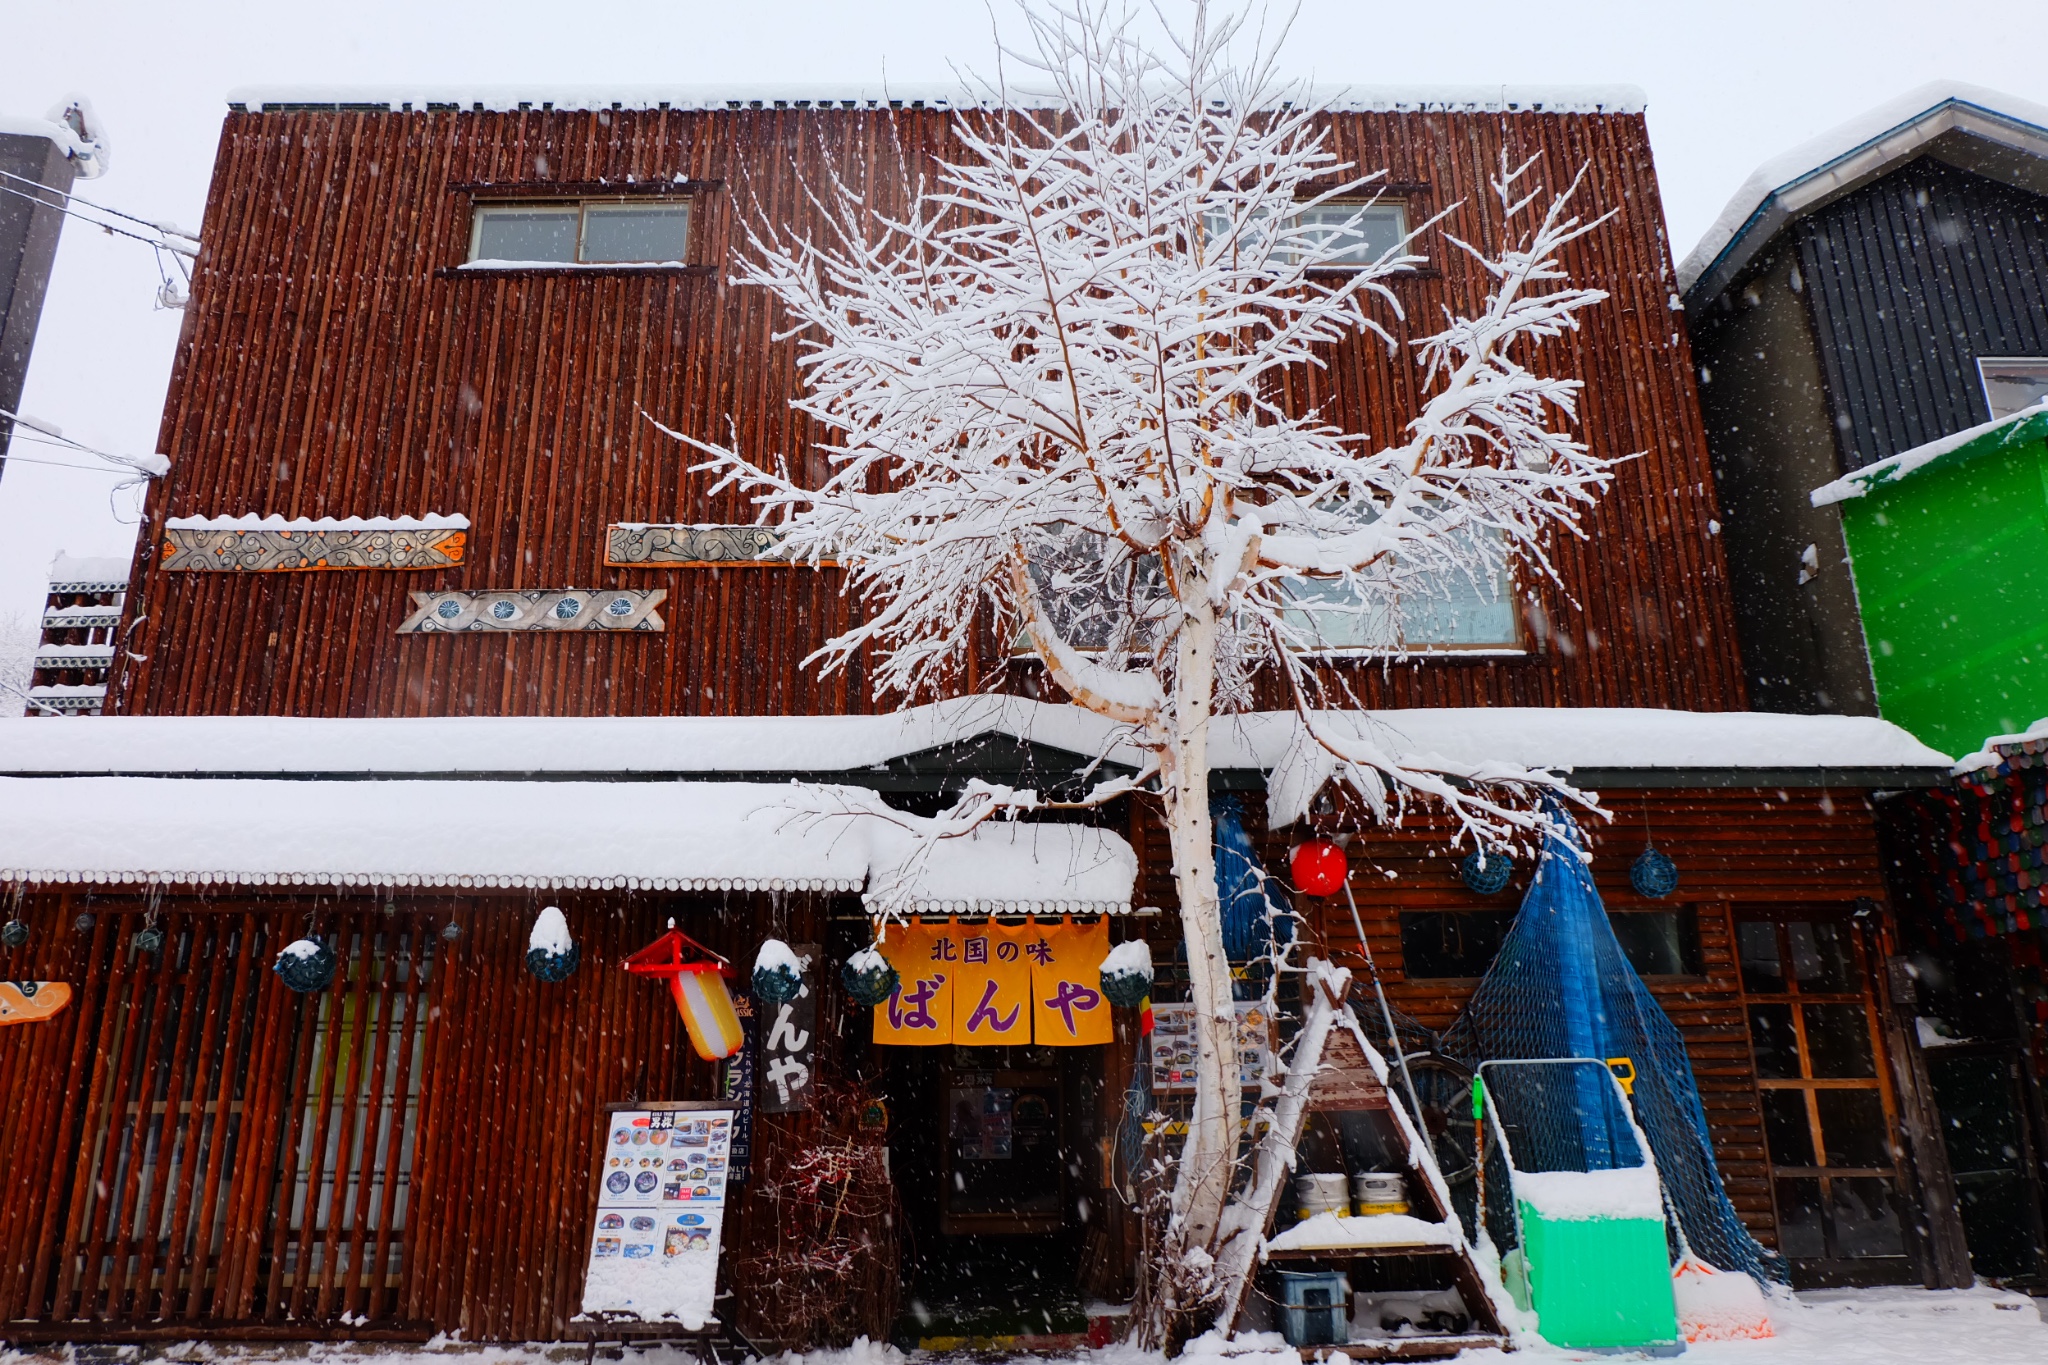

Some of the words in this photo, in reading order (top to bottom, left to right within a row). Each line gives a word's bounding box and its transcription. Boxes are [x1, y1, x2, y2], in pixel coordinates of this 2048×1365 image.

[930, 936, 1055, 966] 北国の味
[735, 1008, 754, 1017] ASSIC
[887, 974, 1100, 1036] ばんや
[728, 1165, 747, 1173] NLY
